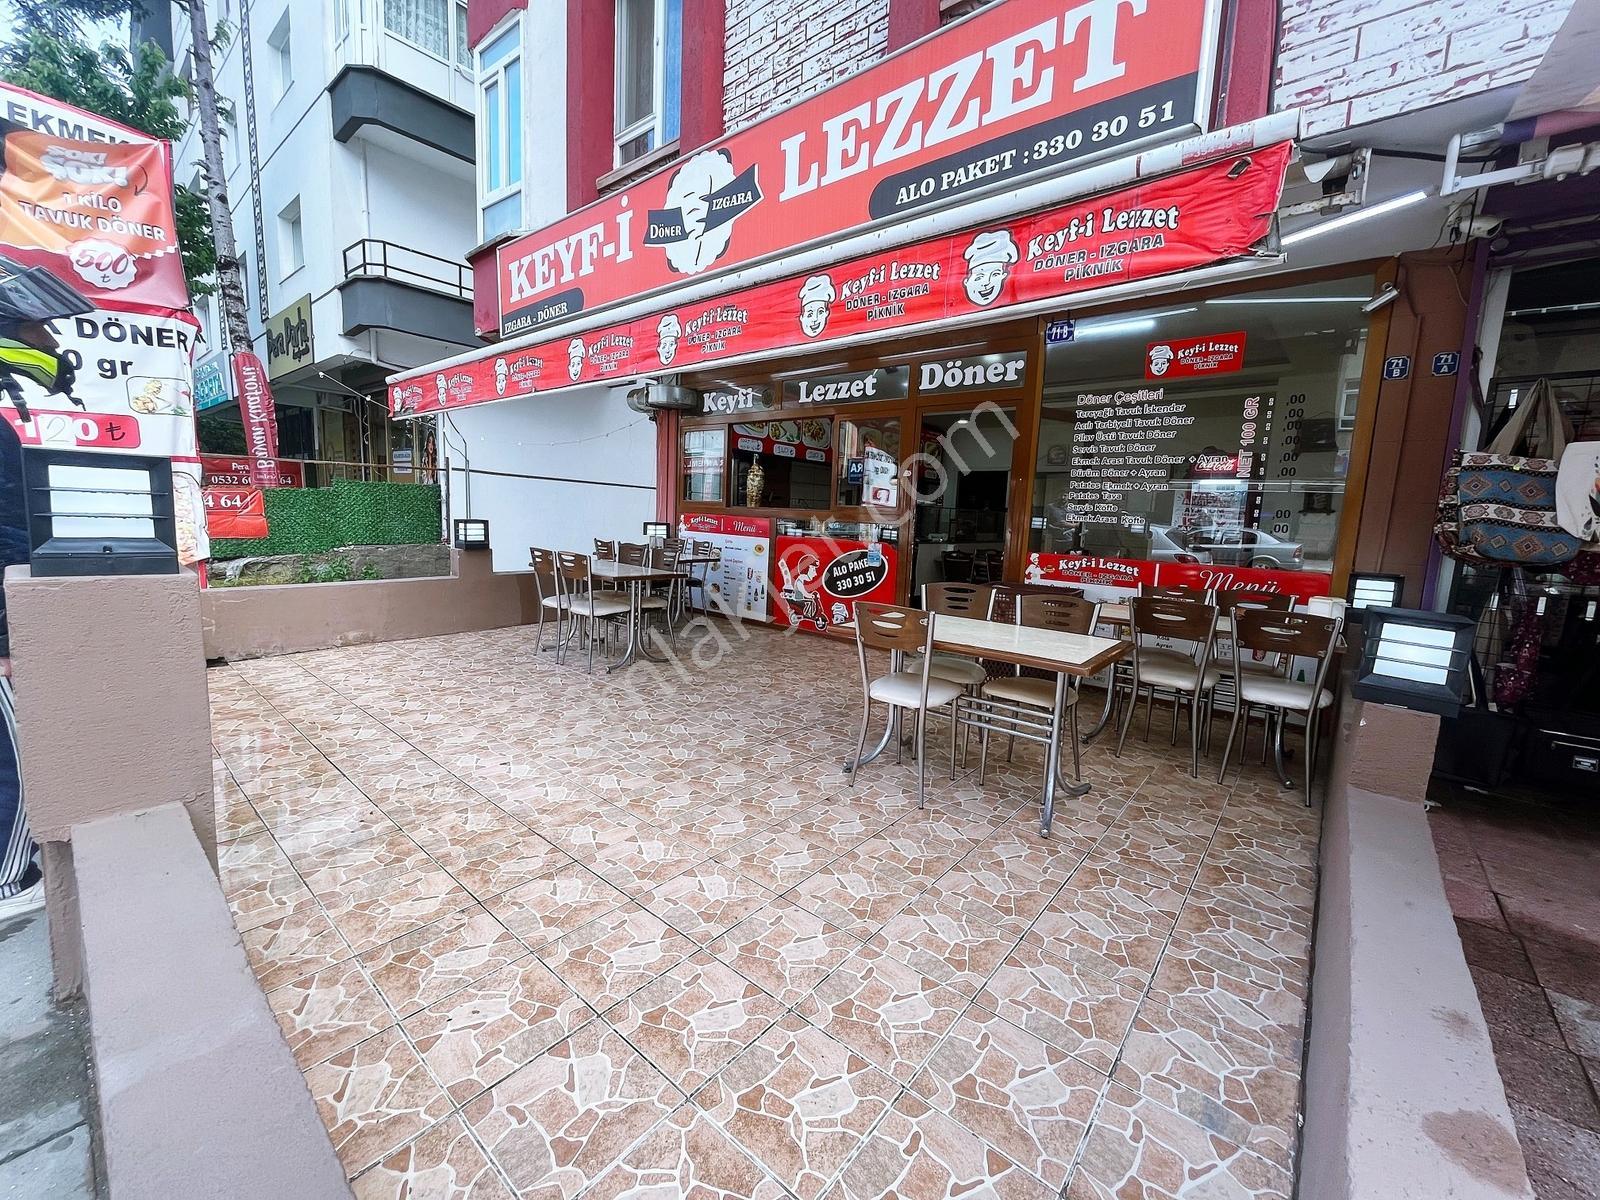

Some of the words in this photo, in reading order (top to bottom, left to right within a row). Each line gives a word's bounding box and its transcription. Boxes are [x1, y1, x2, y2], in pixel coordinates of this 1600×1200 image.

[779, 0, 1149, 202] LEZZET
[895, 175, 935, 205] ALO
[941, 148, 1017, 188] PAKET
[1091, 115, 1129, 142] 30
[1139, 101, 1175, 129] 51
[77, 190, 121, 213] KİLO
[712, 190, 753, 211] IZGARA
[18, 200, 94, 230] TAVUK
[97, 214, 166, 241] DÖNER
[650, 224, 682, 240] DÖNER
[1026, 212, 1095, 262] Keyf-i
[1101, 205, 1180, 234] Lezzet
[75, 249, 130, 275] 500
[1033, 250, 1087, 272] DÖNER
[1100, 234, 1164, 259] IZGARA
[1065, 259, 1123, 281] PİKNİK
[840, 264, 887, 301] Keyf-i
[890, 261, 941, 281] Lezzet
[846, 293, 880, 311] DÖNER
[888, 283, 930, 301] IZGARA
[504, 315, 532, 334] IZGARA
[537, 302, 568, 322] DÖNER
[685, 309, 714, 337] Keyf-i
[716, 306, 748, 323] Lezzet
[867, 303, 905, 321] PİKNİK
[75, 317, 188, 353] DÖNER
[611, 333, 634, 348] Lezzet
[1178, 343, 1206, 359] Keyf-i
[1209, 342, 1239, 353] Lezzet
[1440, 354, 1452, 363] 71
[98, 358, 133, 379] gr
[1391, 359, 1403, 368] 71
[1393, 369, 1400, 377] B
[1440, 365, 1449, 373] A
[919, 357, 1026, 391] Döner
[798, 373, 878, 404] Lezzet
[1077, 394, 1112, 406] Döner
[1114, 388, 1164, 404] Çeşitleri
[702, 387, 754, 415] Keyfi
[1243, 397, 1260, 420] GR
[1075, 408, 1114, 419] Tereyağlı
[1115, 406, 1142, 416] Tavuk
[1143, 403, 1186, 415] İskender
[1094, 419, 1133, 431] Terbiyeli
[1134, 418, 1162, 428] Tavuk
[1162, 415, 1195, 426] Döner
[1073, 433, 1095, 442] Pilav
[1095, 430, 1116, 441] Üstü
[1118, 431, 1145, 440] Tavuk
[1146, 429, 1177, 440] Döner
[1240, 422, 1256, 446] 100
[1072, 445, 1098, 454] Servis
[1099, 444, 1125, 453] Tavuk
[1126, 442, 1157, 453] Döner
[1071, 457, 1100, 466] Ekmek
[1101, 456, 1124, 465] Arası
[1125, 455, 1154, 465] Tavuk
[1154, 453, 1185, 465] Döner
[1198, 454, 1229, 465] Ayran
[1236, 449, 1253, 478] NET
[211, 475, 238, 484] 0532
[1070, 468, 1100, 478] Dürüm
[1101, 468, 1130, 477] Döner
[1138, 468, 1166, 479] Ayran
[1069, 481, 1100, 490] Patates
[1102, 482, 1133, 491] Ekmek
[1141, 482, 1168, 492] Ayran
[220, 494, 241, 508] 64
[1069, 492, 1099, 501] Patates
[1101, 492, 1122, 501] Tava
[1095, 503, 1118, 512] Köfte
[733, 520, 757, 533] Menü
[833, 565, 847, 577] ALO
[848, 558, 869, 573] PAKE
[1058, 558, 1096, 570] Keyf-i
[1099, 558, 1139, 577] Lezzet
[836, 578, 852, 591] 330
[853, 574, 864, 586] 30
[866, 571, 876, 582] 51
[1200, 570, 1281, 594] Menü
